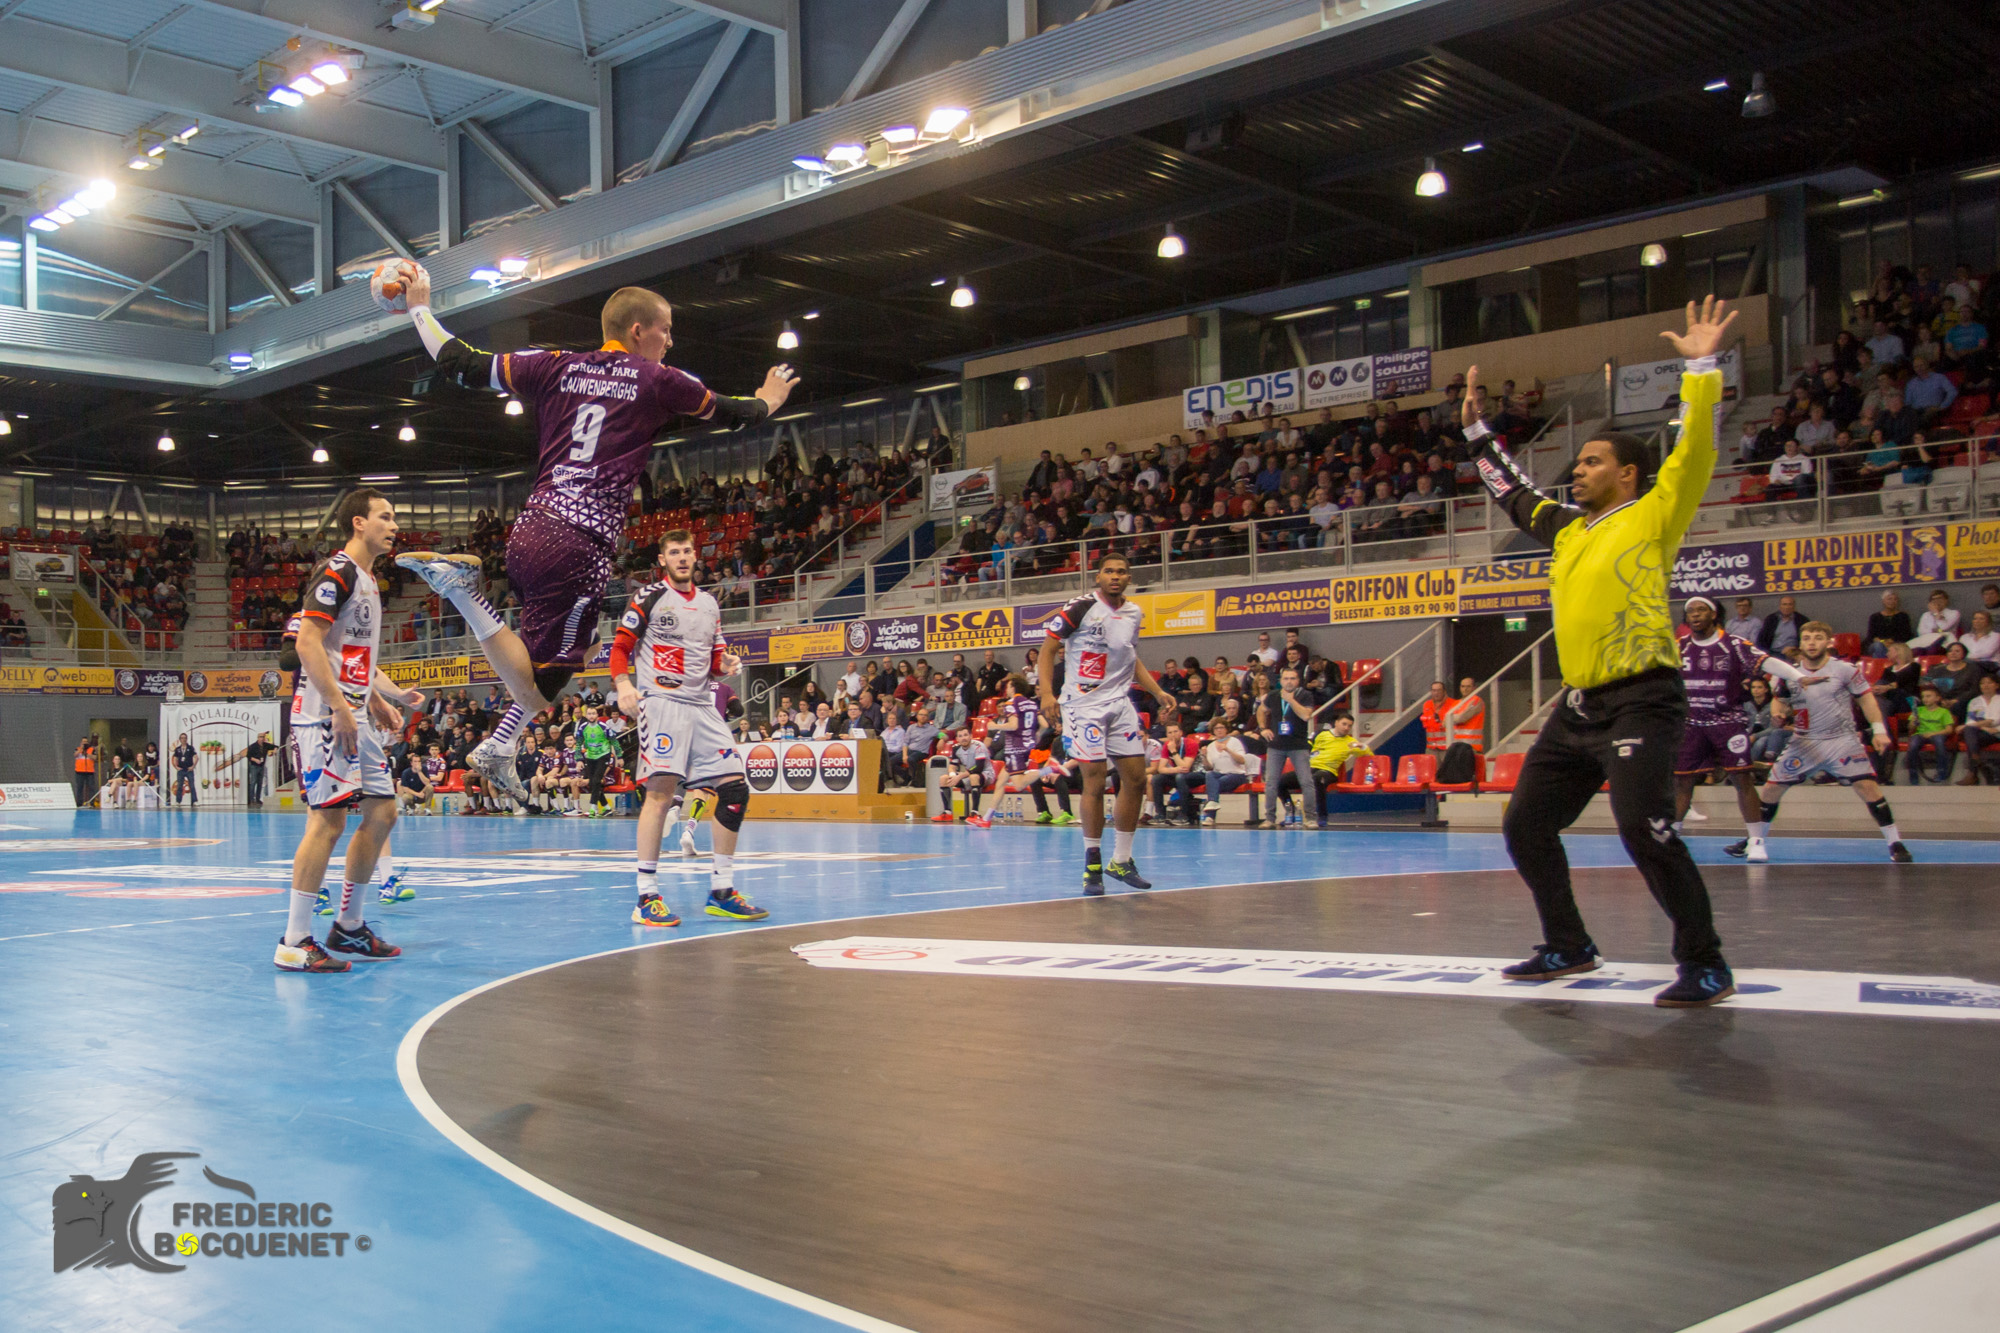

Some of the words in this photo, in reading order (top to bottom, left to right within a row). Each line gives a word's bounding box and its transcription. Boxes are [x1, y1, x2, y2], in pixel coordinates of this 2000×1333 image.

[1375, 350, 1428, 365] Philippe
[611, 366, 639, 378] PARK
[1375, 361, 1428, 377] SOULAT
[1654, 364, 1680, 374] OPEL
[560, 376, 638, 401] CAUWENBERGHS
[1309, 390, 1369, 405] ENTREPRISE
[569, 403, 607, 463] 9
[1767, 542, 1787, 566] LE
[1793, 532, 1899, 565] JARDINIER
[1461, 560, 1550, 584] FASSLE
[1765, 561, 1901, 582] SELESTAT
[1333, 575, 1408, 604] GRIFFON
[1415, 569, 1455, 598] Club
[1765, 581, 1788, 592] 03
[1792, 579, 1815, 590] 88
[1820, 577, 1844, 588] 92
[1848, 575, 1872, 586] 09
[1877, 573, 1902, 584] 92
[1243, 587, 1330, 604] JOAQUIM
[1241, 599, 1330, 615] ARMINDO
[1334, 607, 1374, 620] SELESTAT
[1384, 606, 1396, 616] 03
[1398, 605, 1410, 615] 88
[1413, 604, 1425, 614] 92
[1428, 603, 1440, 613] 90
[1443, 602, 1456, 612] 90
[660, 616, 674, 626] 95
[927, 609, 1010, 633] ISCA
[1164, 617, 1205, 628] CUISINE
[878, 622, 919, 635] victoire
[927, 628, 1011, 642] INFORMATIQUE
[1091, 626, 1102, 636] 24
[727, 643, 750, 657] ÉSIA
[423, 657, 457, 668] RESTAURANT
[384, 667, 420, 681] ERMO
[421, 669, 427, 679] A
[429, 667, 438, 678] LA
[440, 665, 468, 678] TRUITE
[182, 708, 259, 727] POULAILLON
[747, 758, 776, 768] SPORT
[784, 758, 814, 767] SPORT
[821, 757, 852, 767] SPORT
[750, 769, 774, 777] 2000
[787, 768, 812, 777] 2000
[824, 768, 849, 777] 2000
